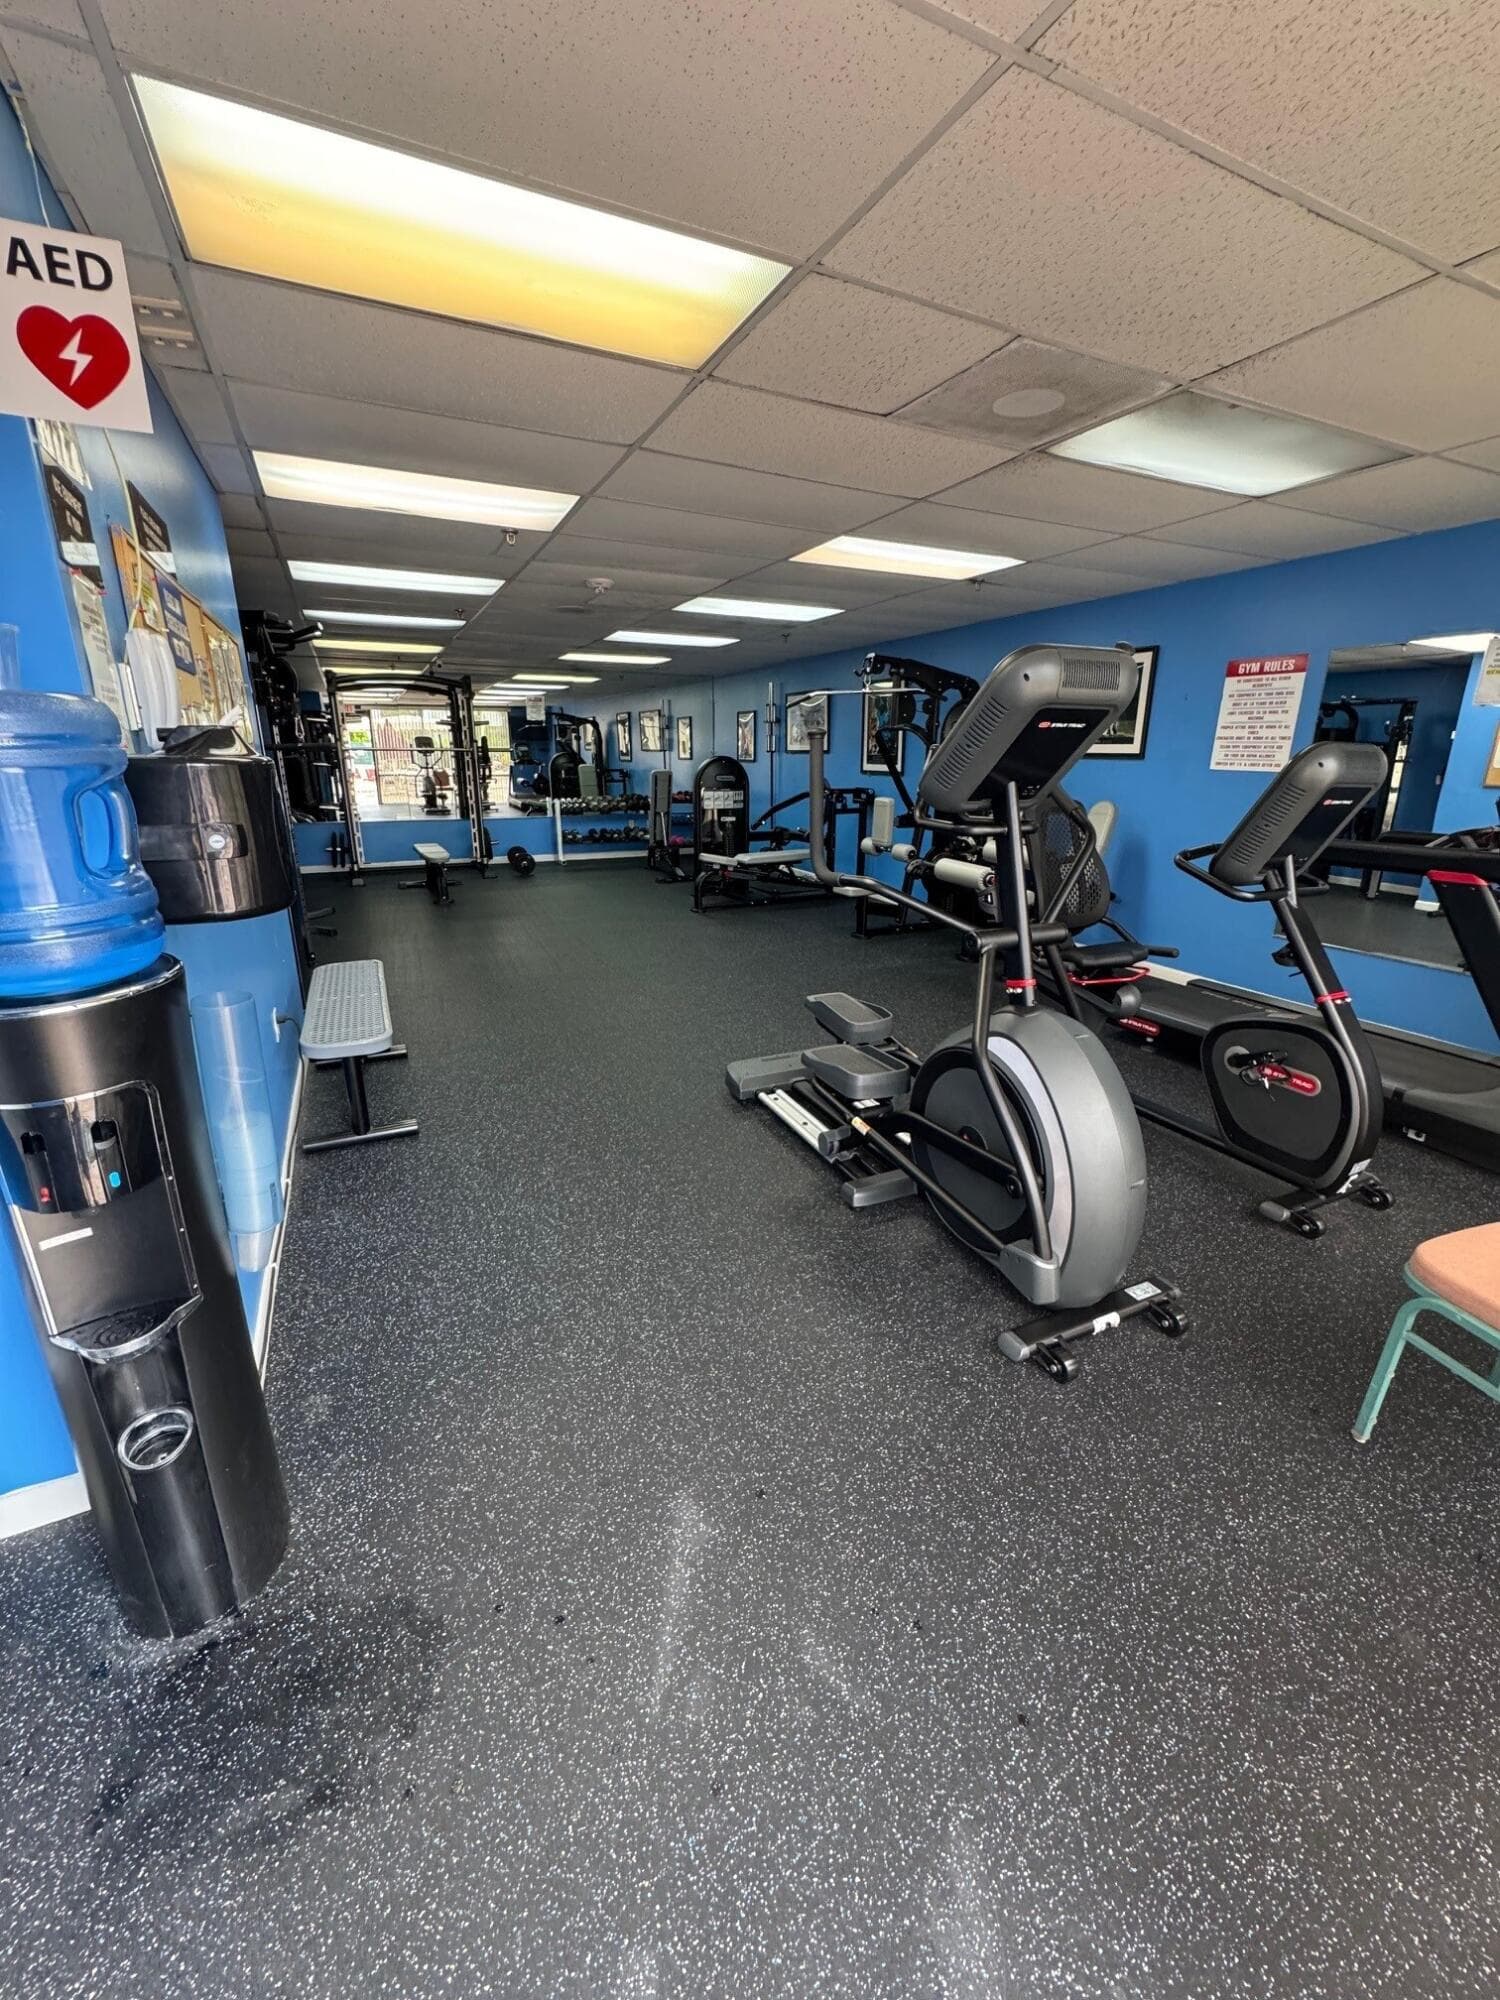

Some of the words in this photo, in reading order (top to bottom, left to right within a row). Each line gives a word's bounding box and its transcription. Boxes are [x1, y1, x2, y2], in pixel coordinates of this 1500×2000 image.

[6, 236, 113, 291] AED
[1238, 662, 1260, 674] GYM
[1263, 659, 1295, 672] RULES
[1292, 1078, 1314, 1089] TRAC
